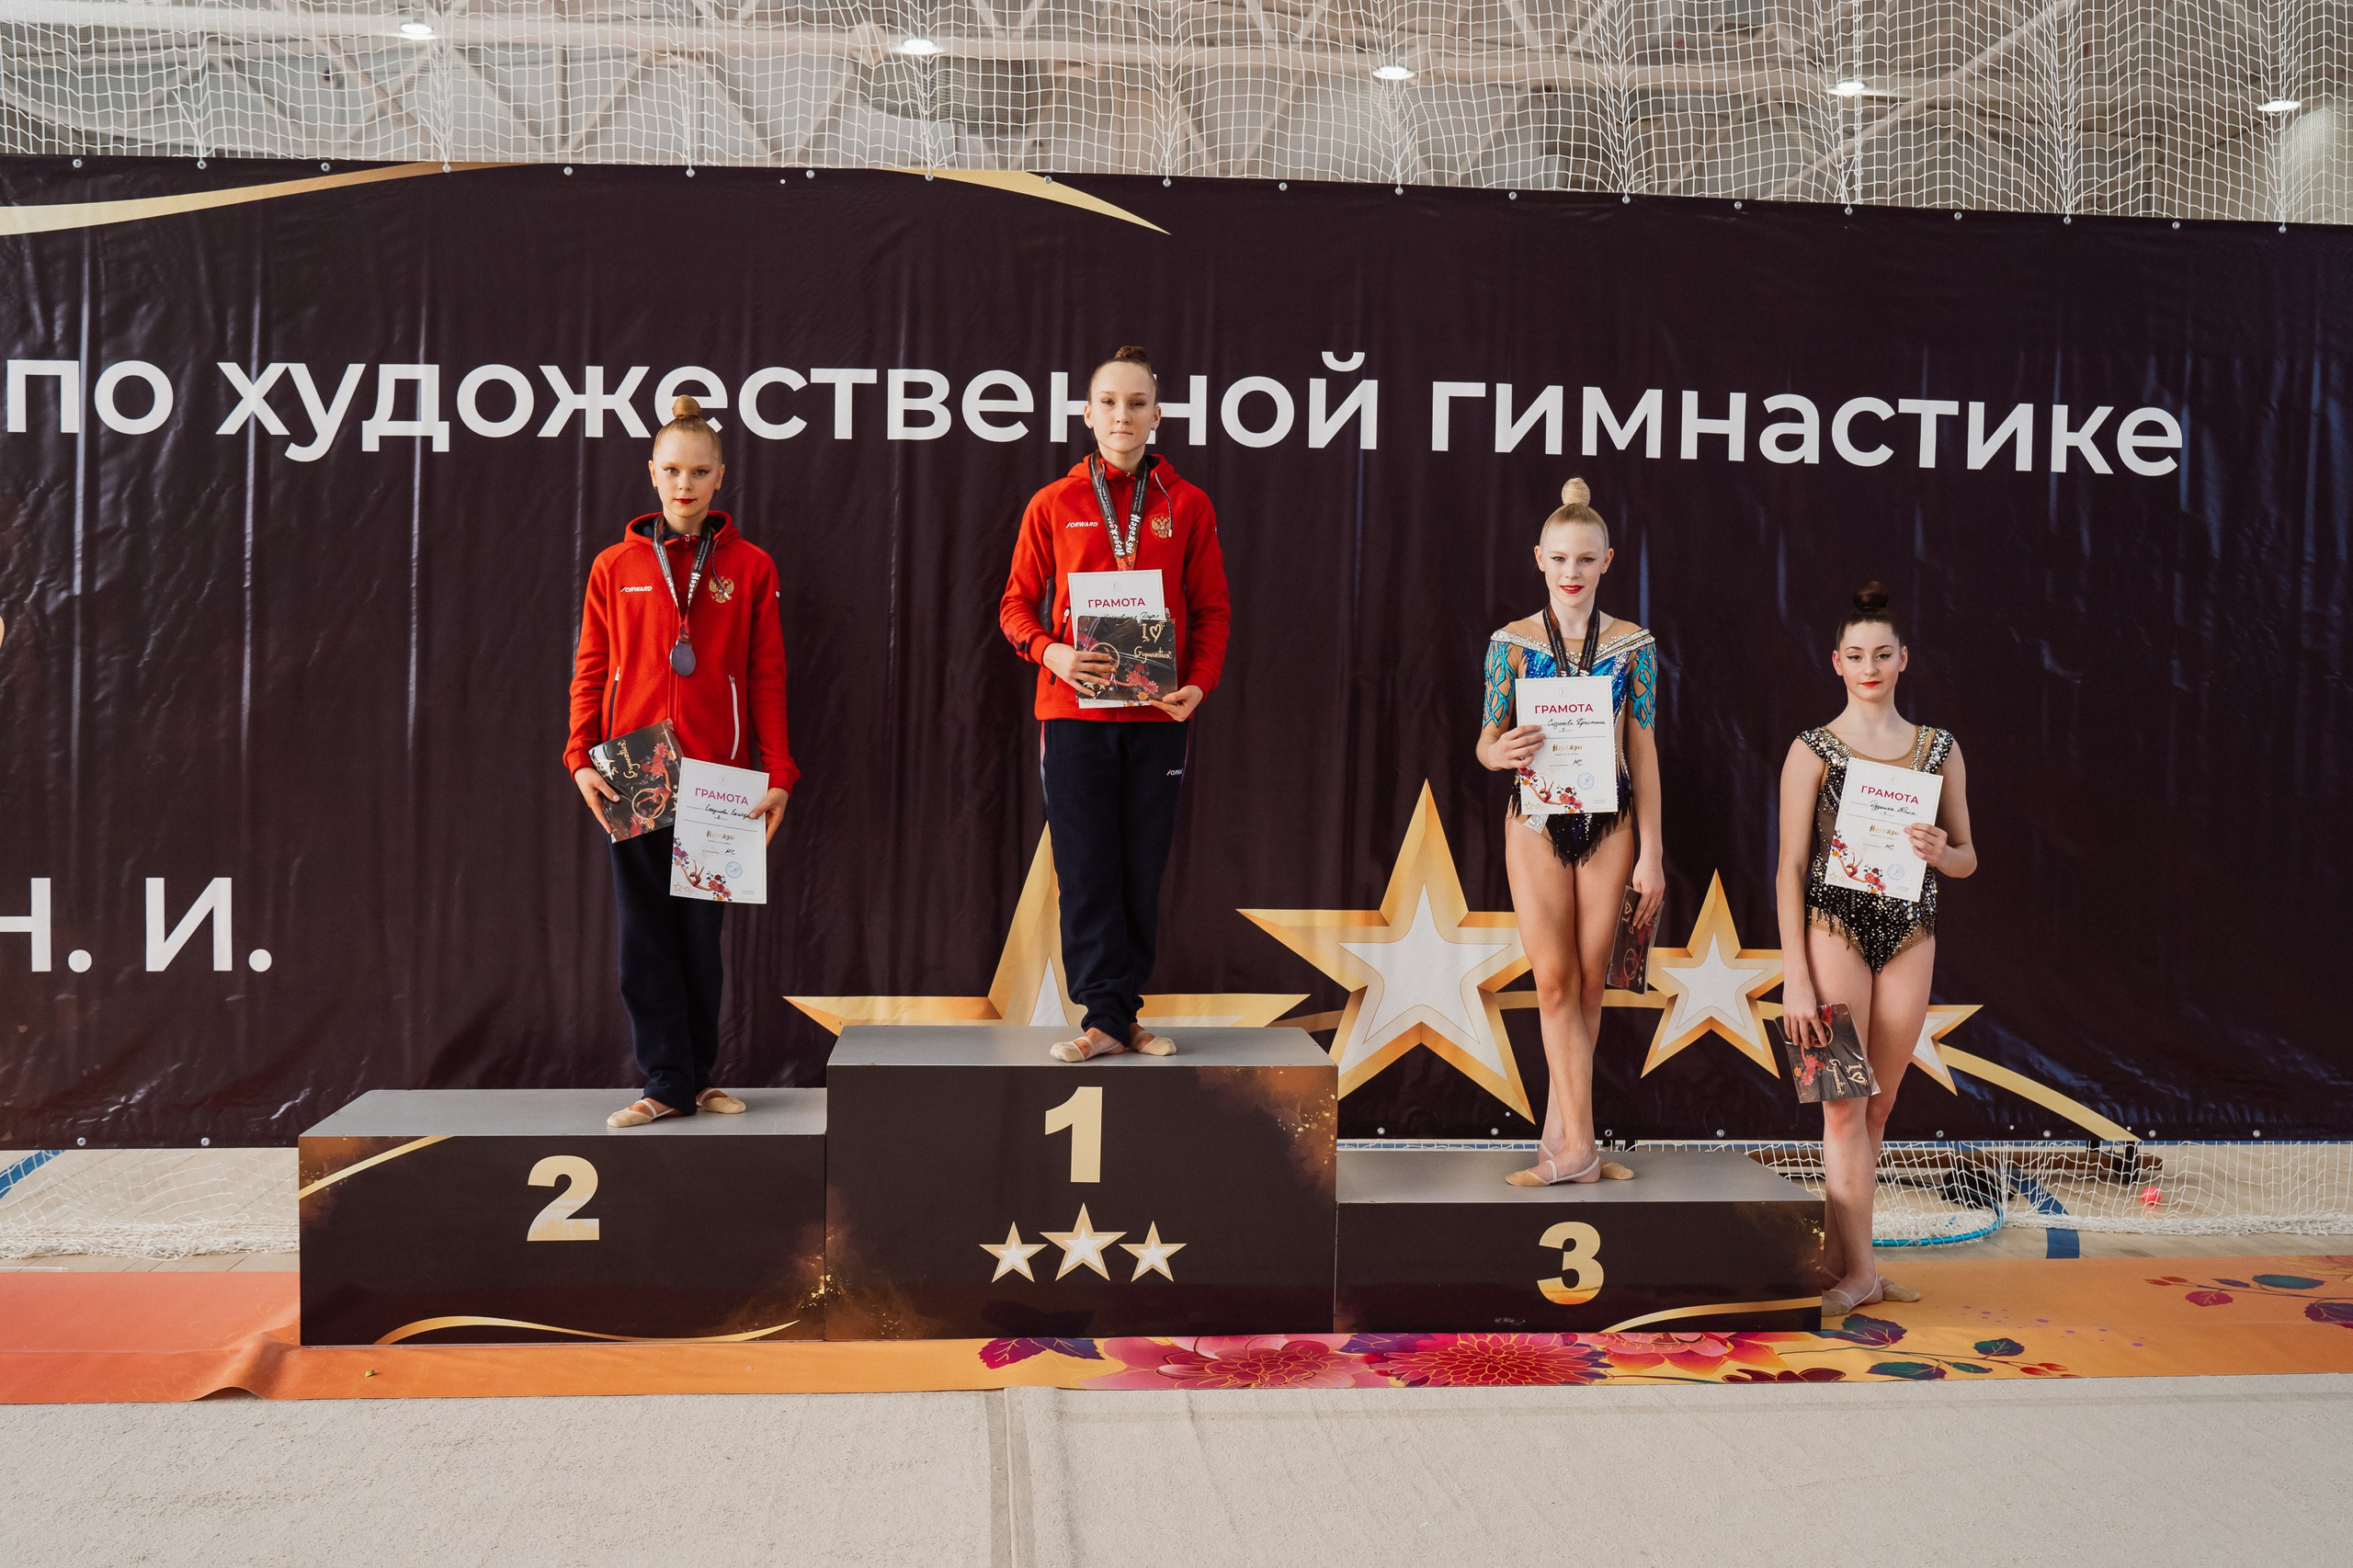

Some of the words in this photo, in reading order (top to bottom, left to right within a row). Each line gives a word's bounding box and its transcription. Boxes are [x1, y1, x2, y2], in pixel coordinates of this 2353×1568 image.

[6, 359, 175, 435] по
[216, 351, 1379, 461] художественной
[1431, 381, 2184, 476] гимнастике
[1065, 521, 1098, 529] FORWARD
[1125, 513, 1142, 554] Надежды
[1087, 597, 1146, 608] ГРАМОТА
[1534, 703, 1594, 714] ГРАМОТА
[694, 787, 749, 806] ГРАМОТА
[1860, 785, 1919, 805] ГРАМОТА
[144, 877, 273, 972] И.
[1044, 1085, 1103, 1184] 1
[527, 1155, 599, 1242] 2
[1537, 1221, 1604, 1305] 3
